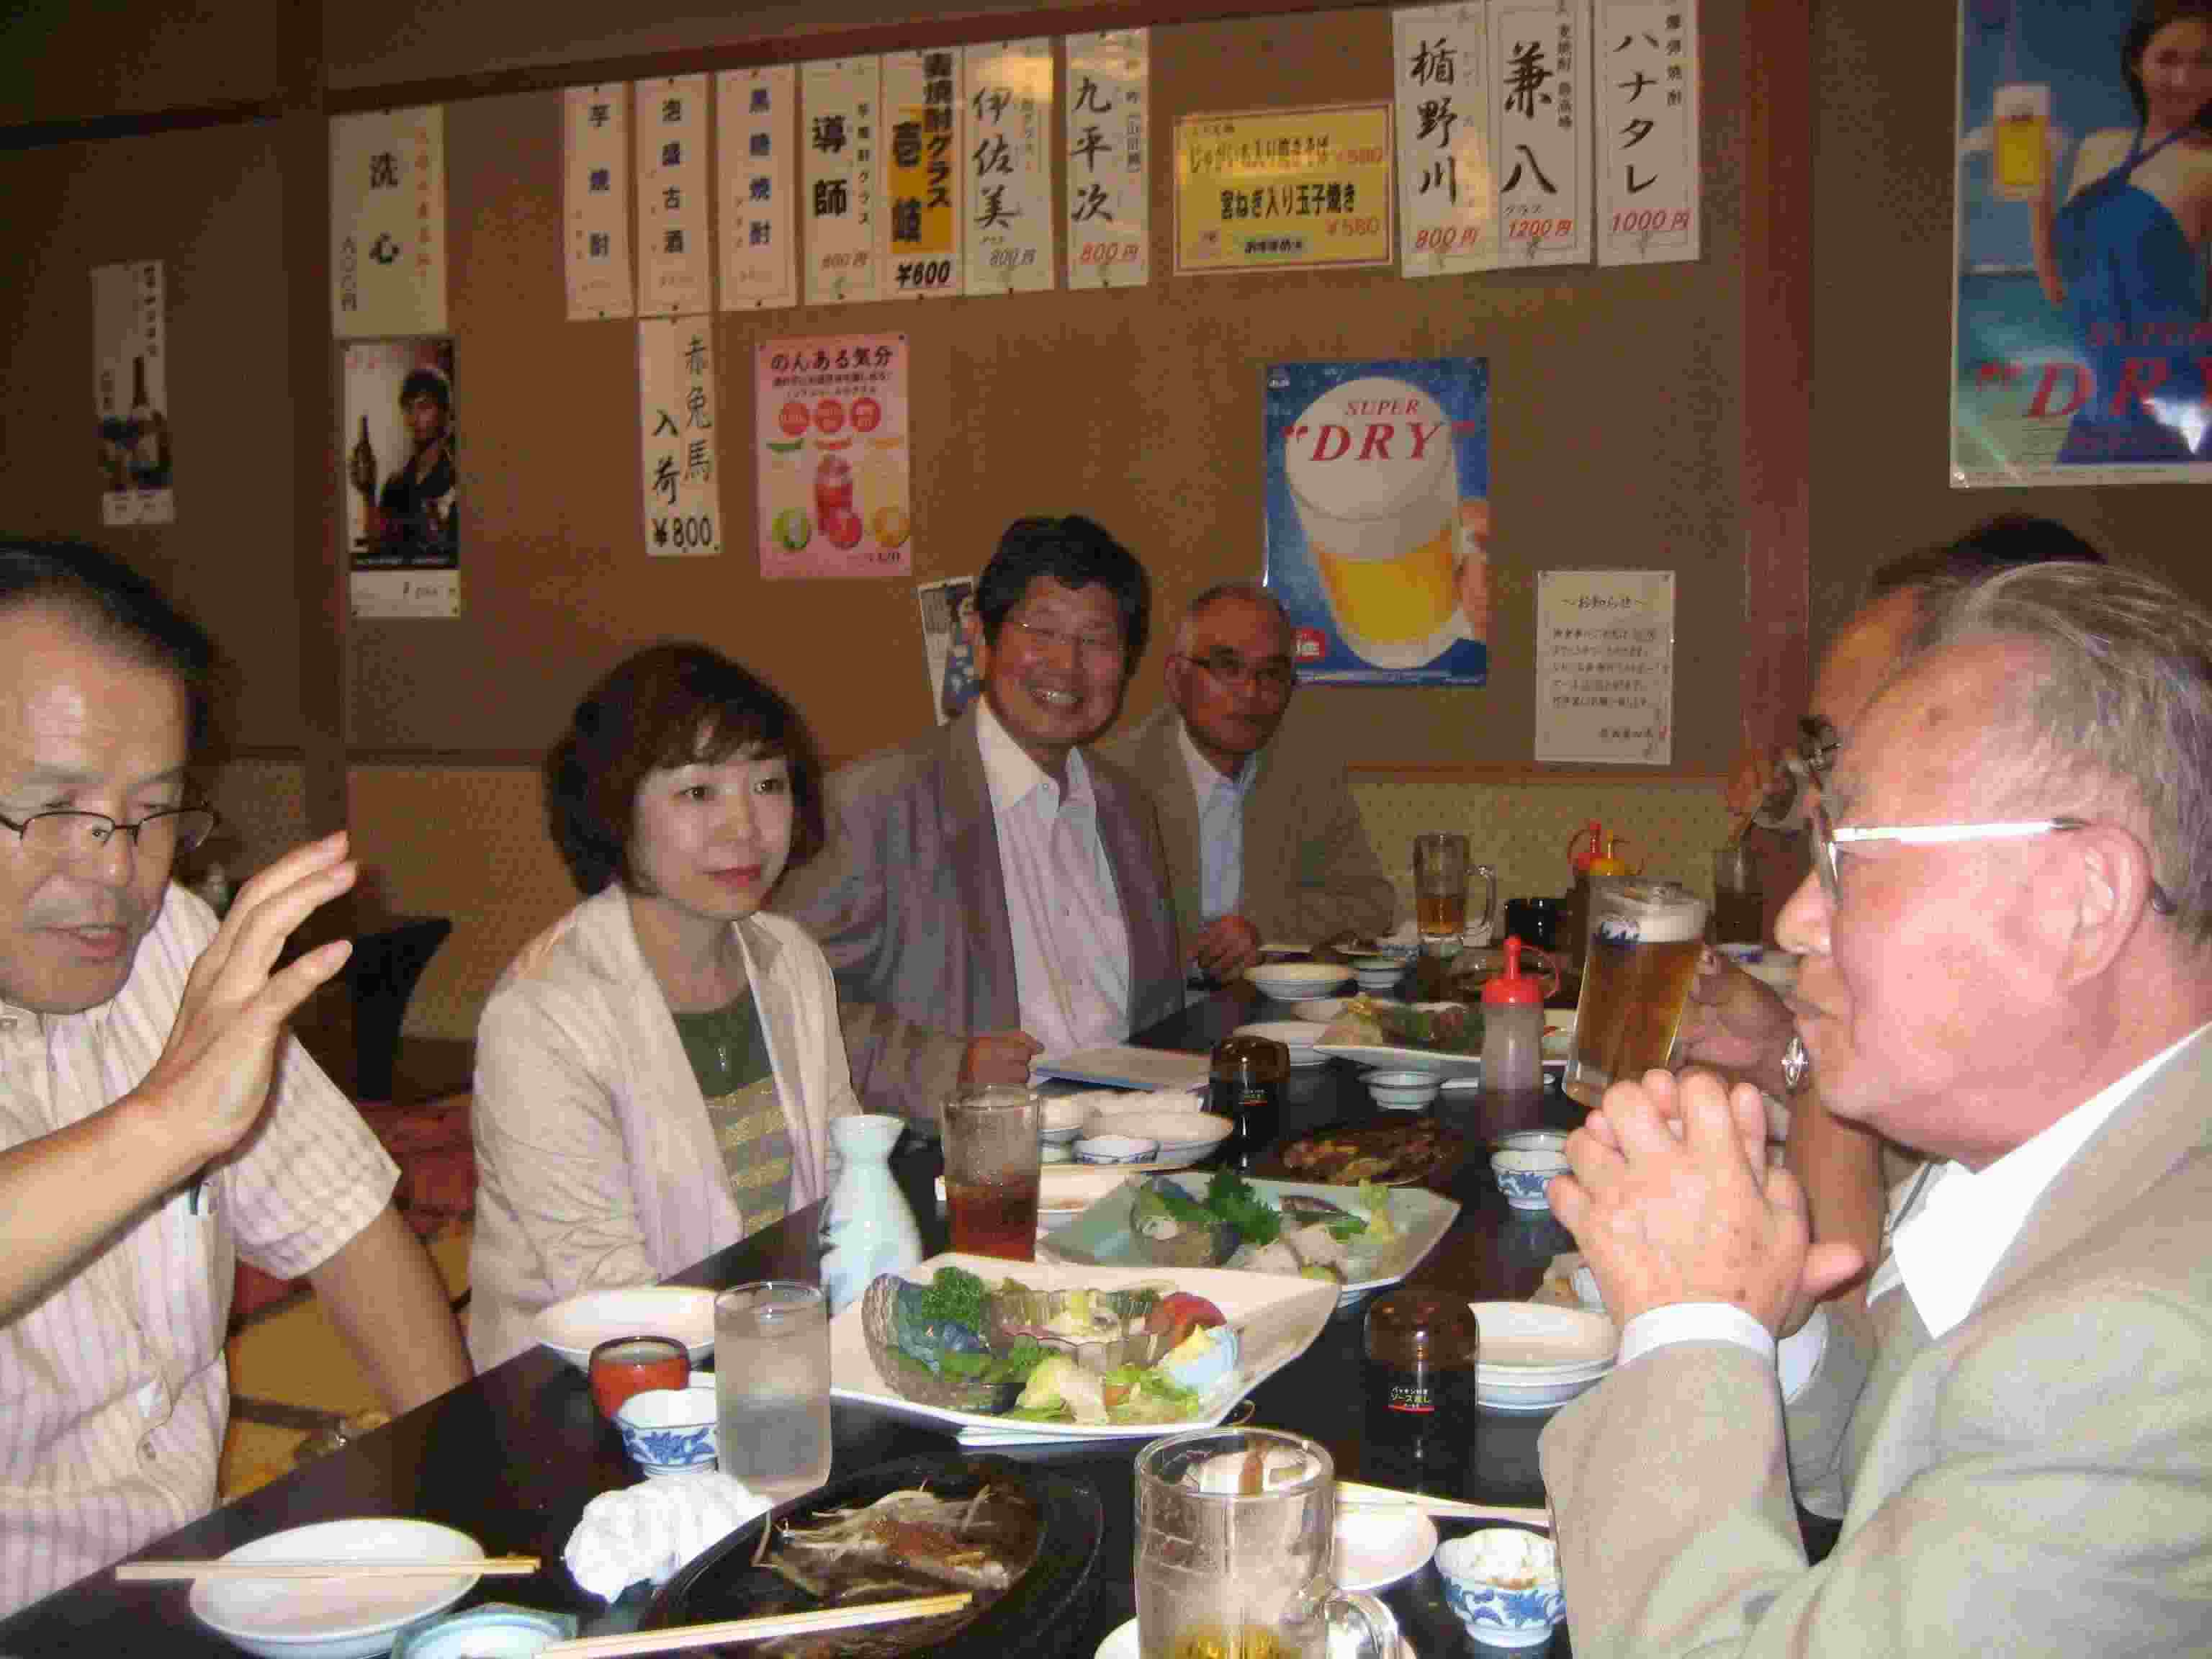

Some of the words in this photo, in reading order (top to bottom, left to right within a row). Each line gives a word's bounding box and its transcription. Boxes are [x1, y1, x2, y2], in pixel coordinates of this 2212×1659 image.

[1409, 37, 1458, 205] 楯野川
[1500, 40, 1558, 194] 兼八
[1613, 31, 1660, 194] ハナタレ
[972, 85, 1022, 230] 伊佐美
[1070, 75, 1113, 224] 九平次
[368, 151, 400, 266] 洗心
[1612, 209, 1691, 232] 1000円
[1415, 226, 1479, 249] 800円
[1509, 219, 1573, 238] 1200円
[1080, 241, 1140, 262] 800円
[894, 260, 950, 287] ¥600
[770, 345, 894, 373] のんある気分
[1344, 397, 1421, 416] SUPER
[651, 408, 680, 505] 入荷
[652, 515, 713, 548] ¥800
